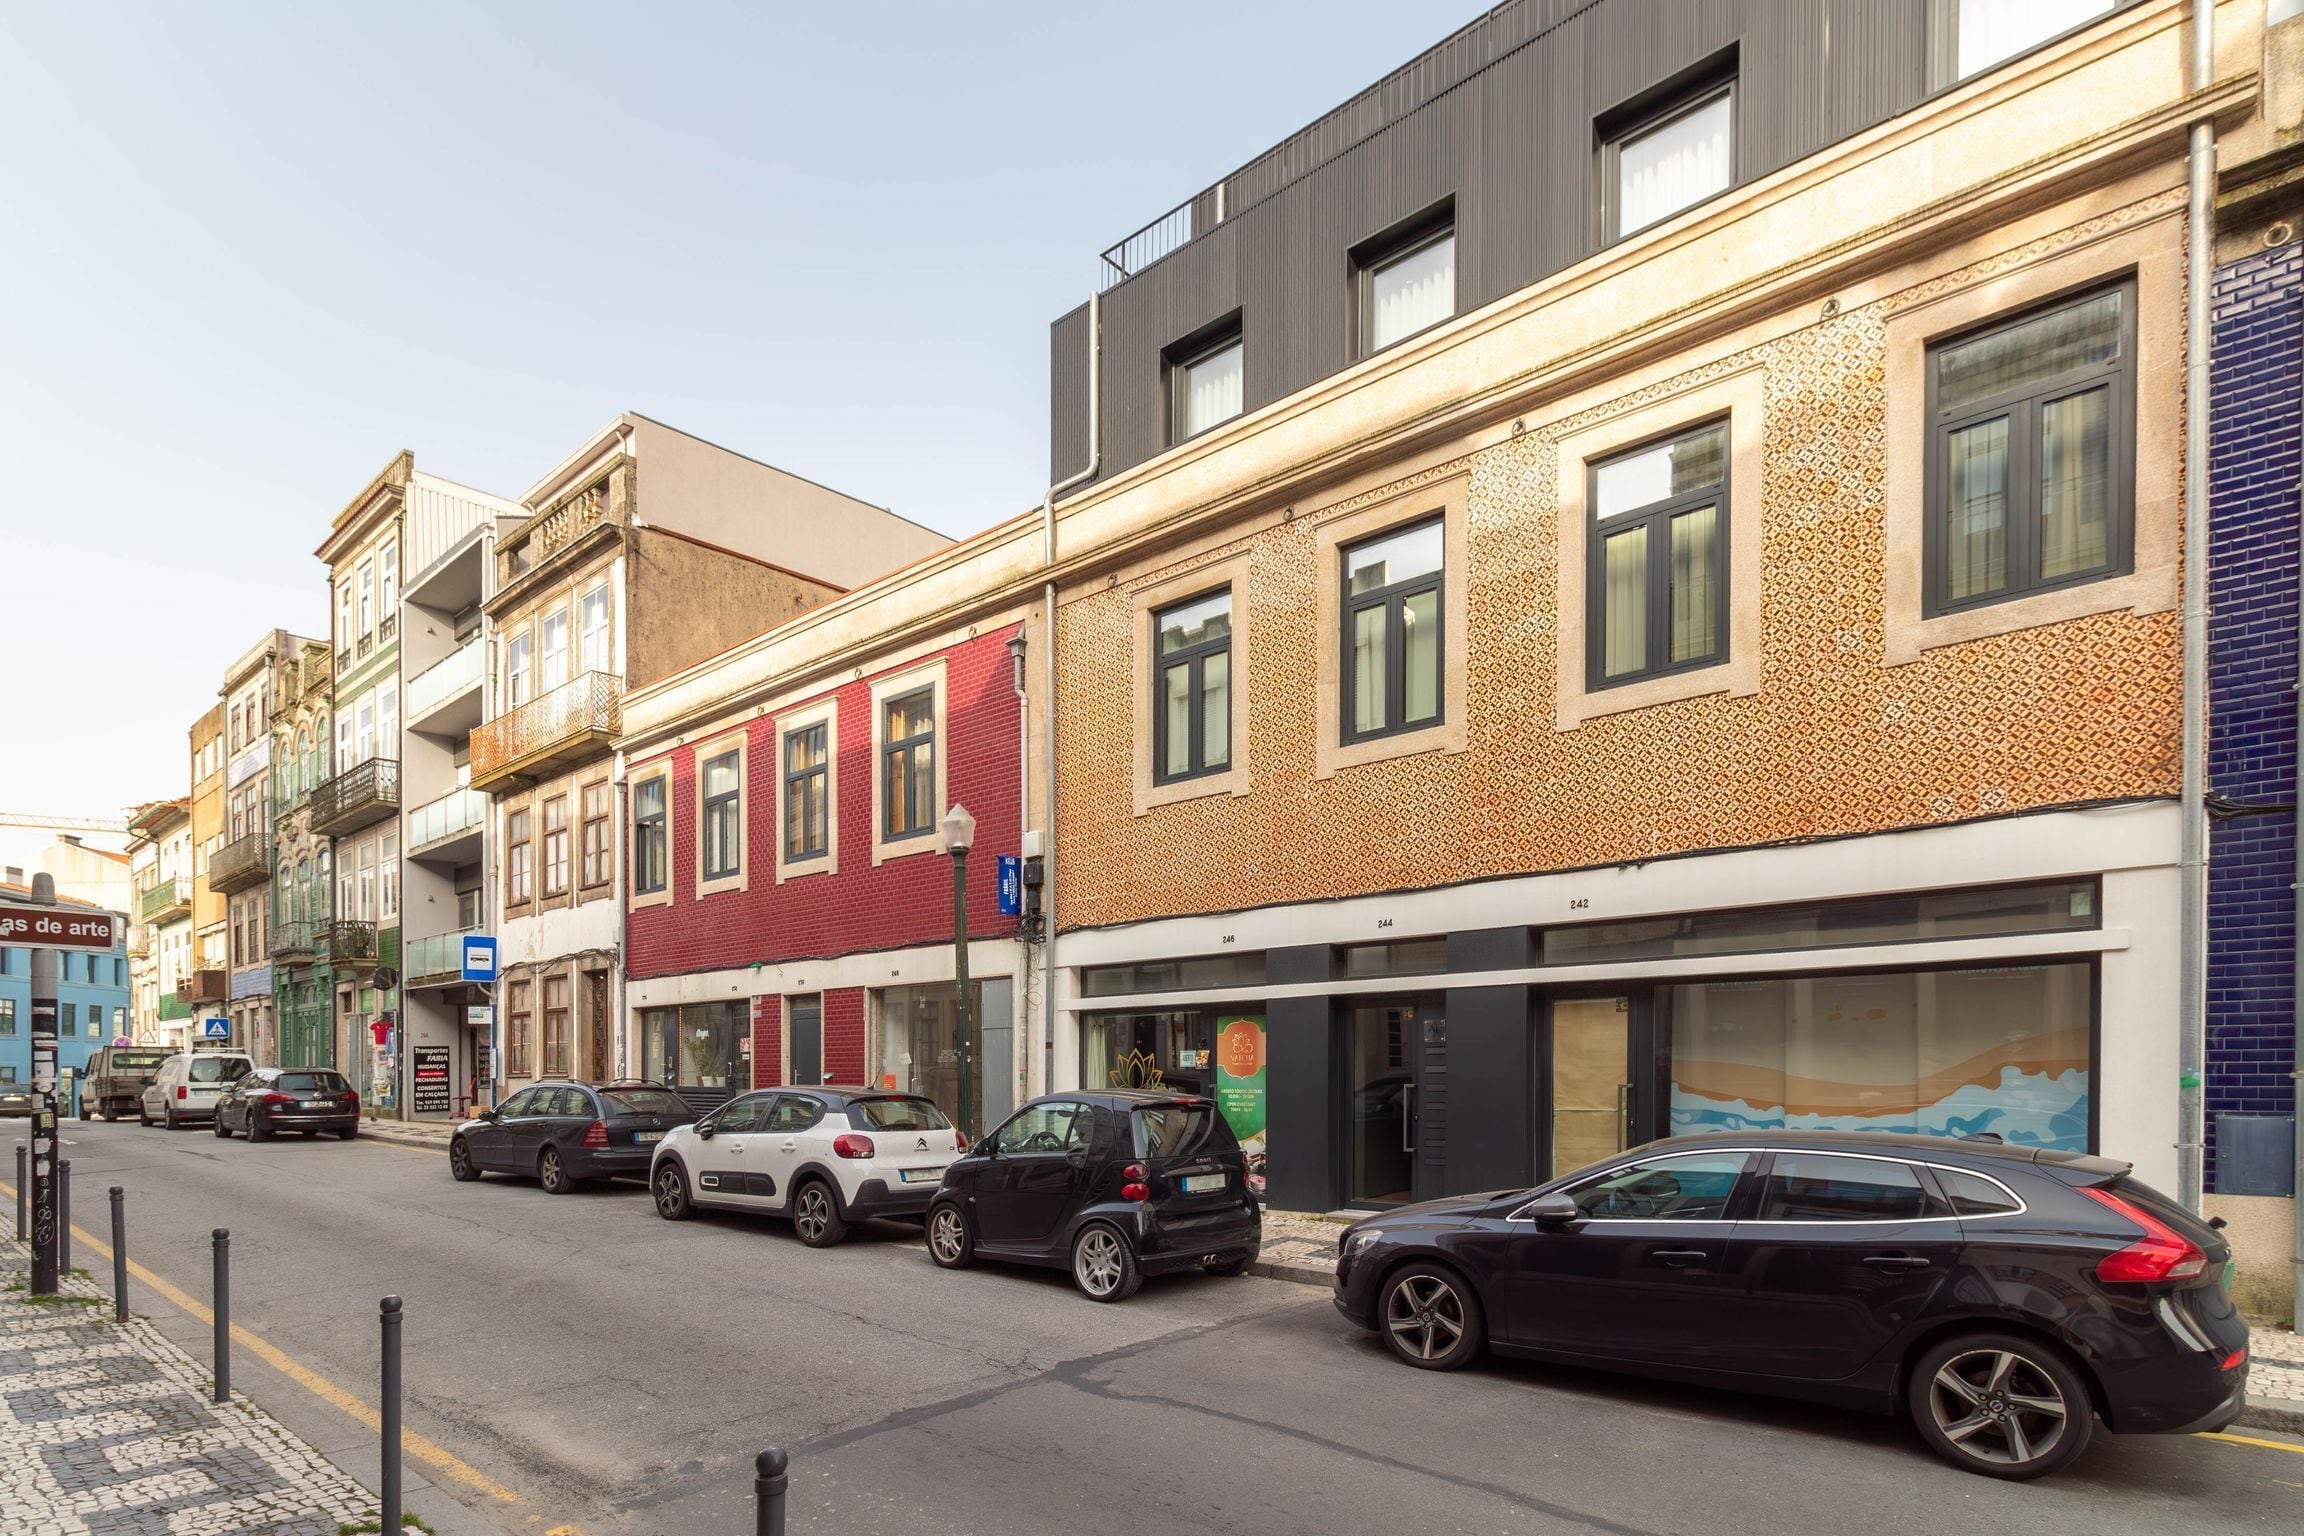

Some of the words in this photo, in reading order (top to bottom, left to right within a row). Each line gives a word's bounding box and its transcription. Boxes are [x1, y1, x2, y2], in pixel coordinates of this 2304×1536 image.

[1570, 899, 1589, 910] 242
[35, 917, 62, 934] de
[69, 922, 109, 937] arte
[1377, 918, 1393, 928] 244
[1222, 934, 1235, 944] 246
